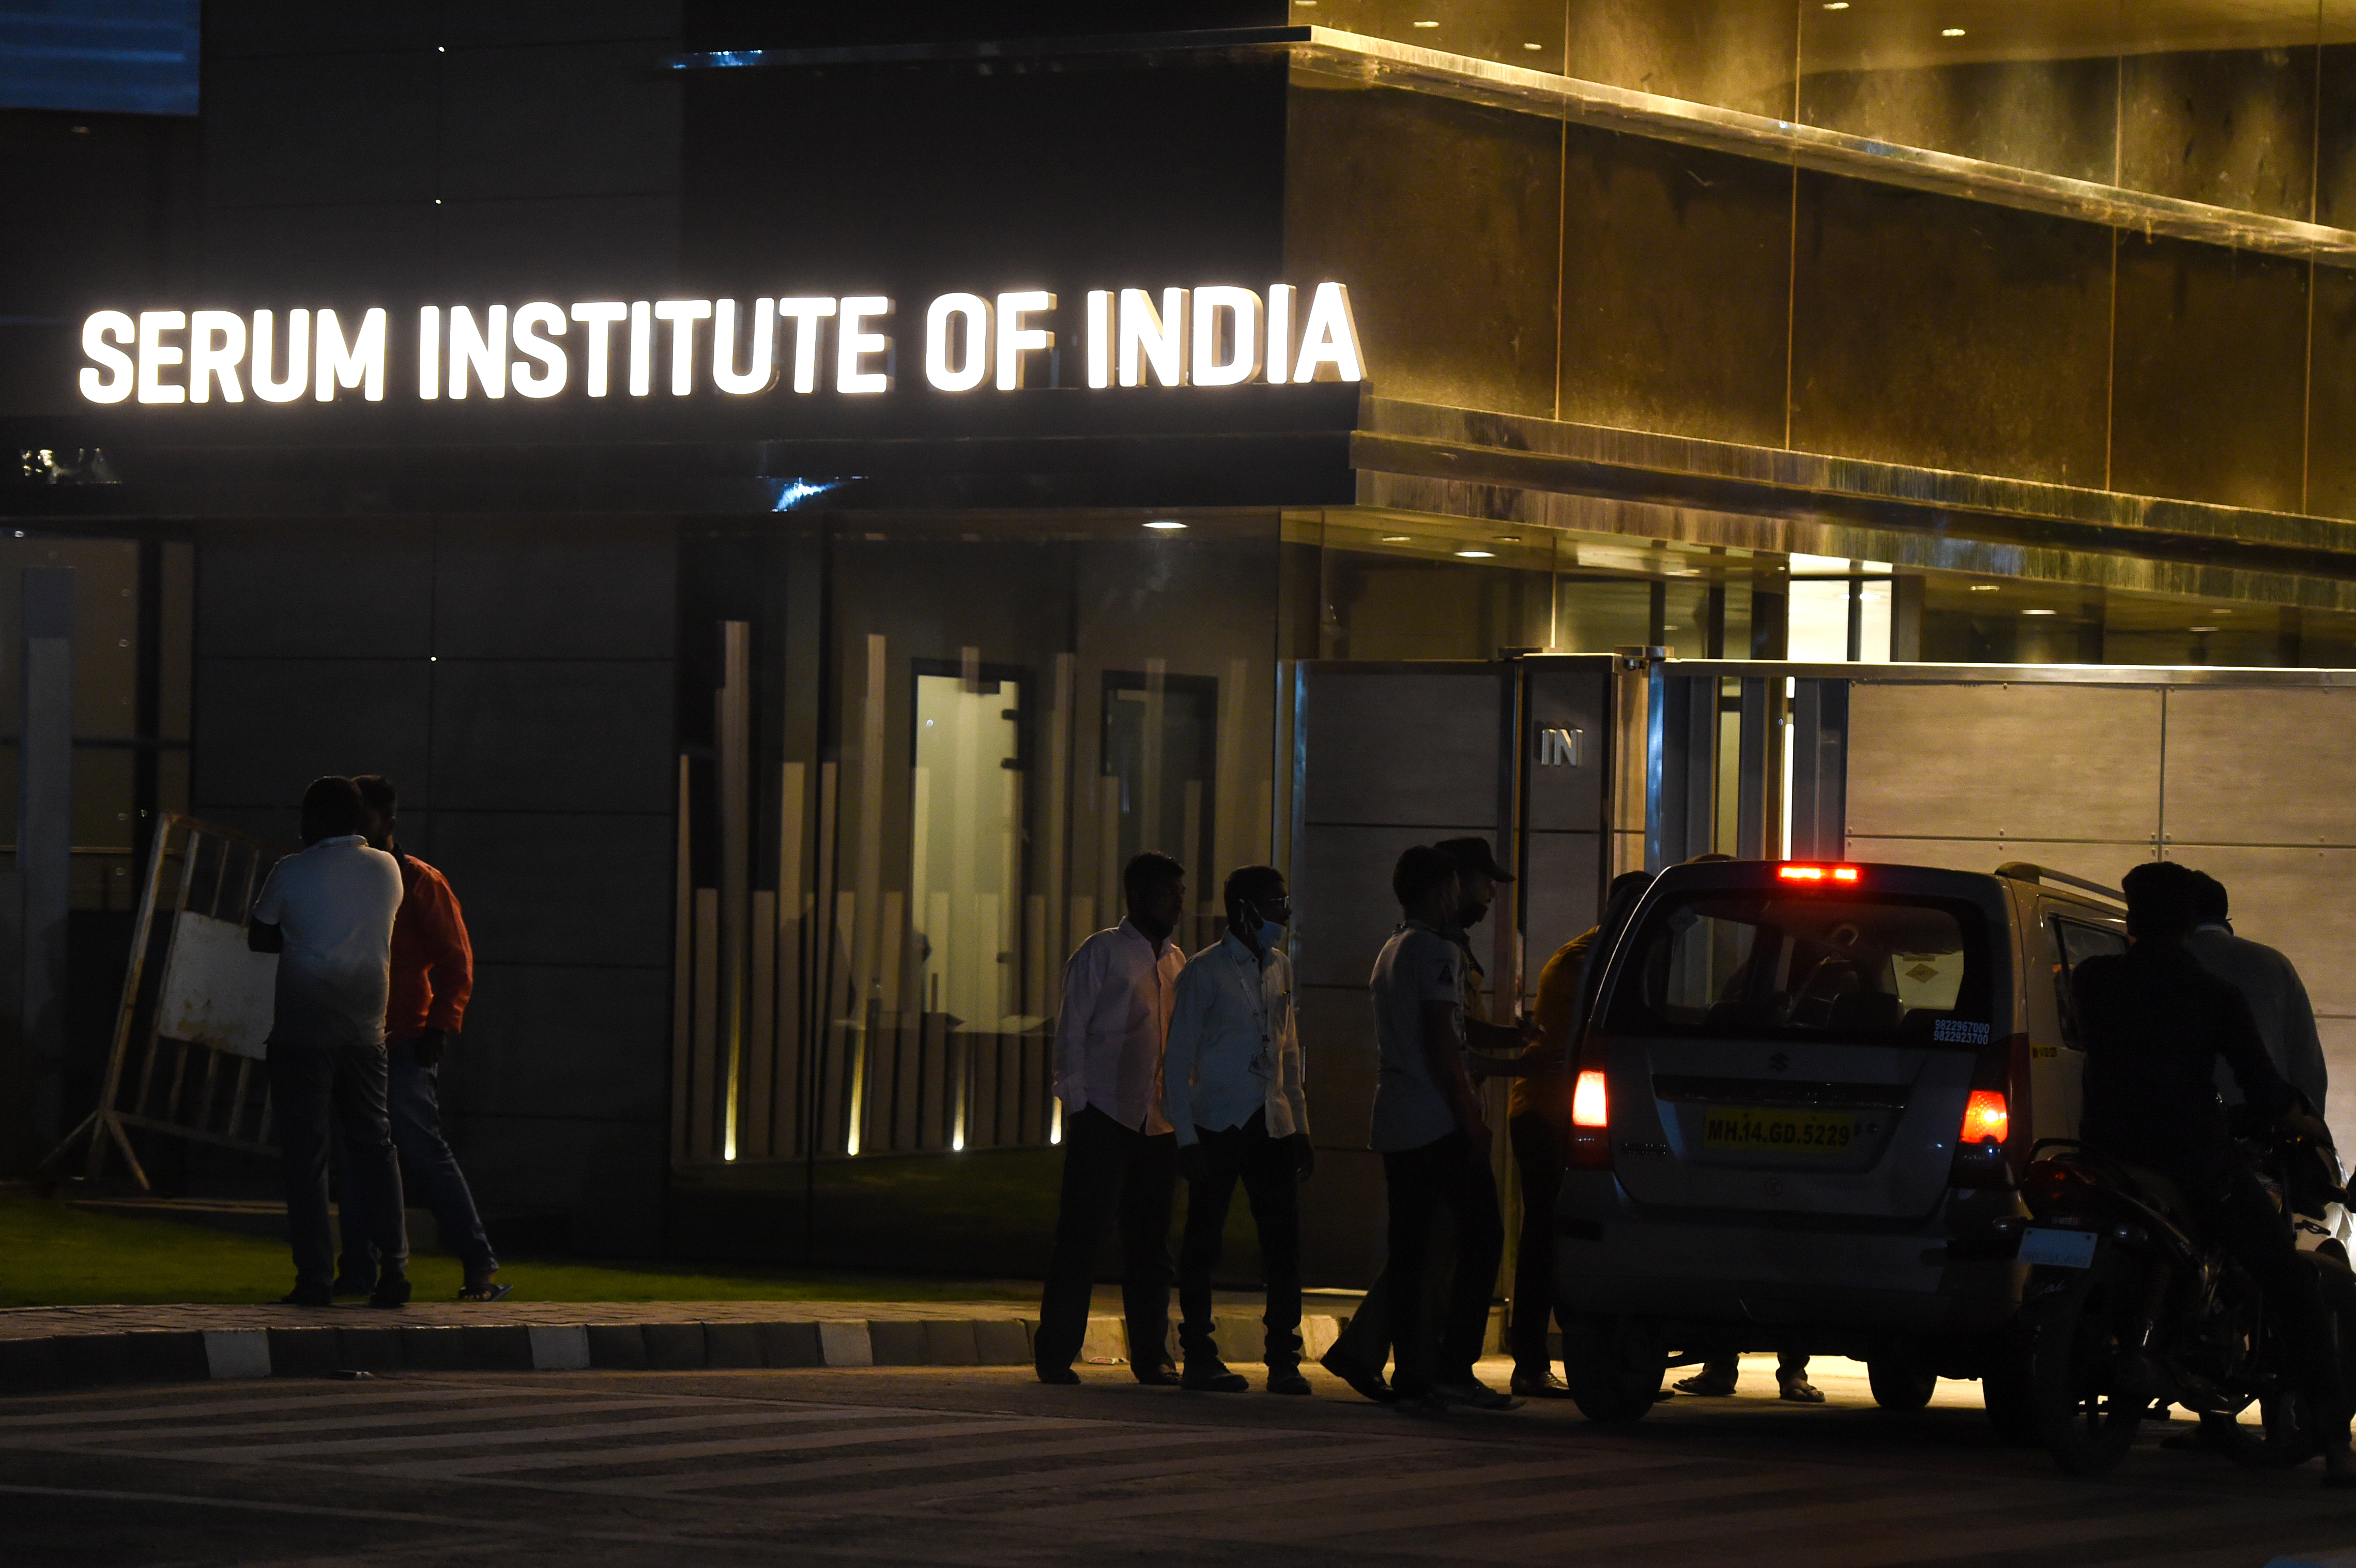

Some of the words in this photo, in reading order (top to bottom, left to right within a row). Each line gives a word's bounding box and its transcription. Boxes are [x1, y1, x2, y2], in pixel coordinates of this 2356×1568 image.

[79, 308, 386, 404] SERUM
[419, 296, 893, 400] INSTITUTE
[925, 291, 1057, 392] OF
[1087, 282, 1368, 389] INDIA
[1541, 728, 1583, 766] IN
[1934, 1030, 1988, 1044] 9822923700
[1935, 1019, 1990, 1034] 9822967000
[1707, 1119, 1850, 1146] MH.14.GD.5229
